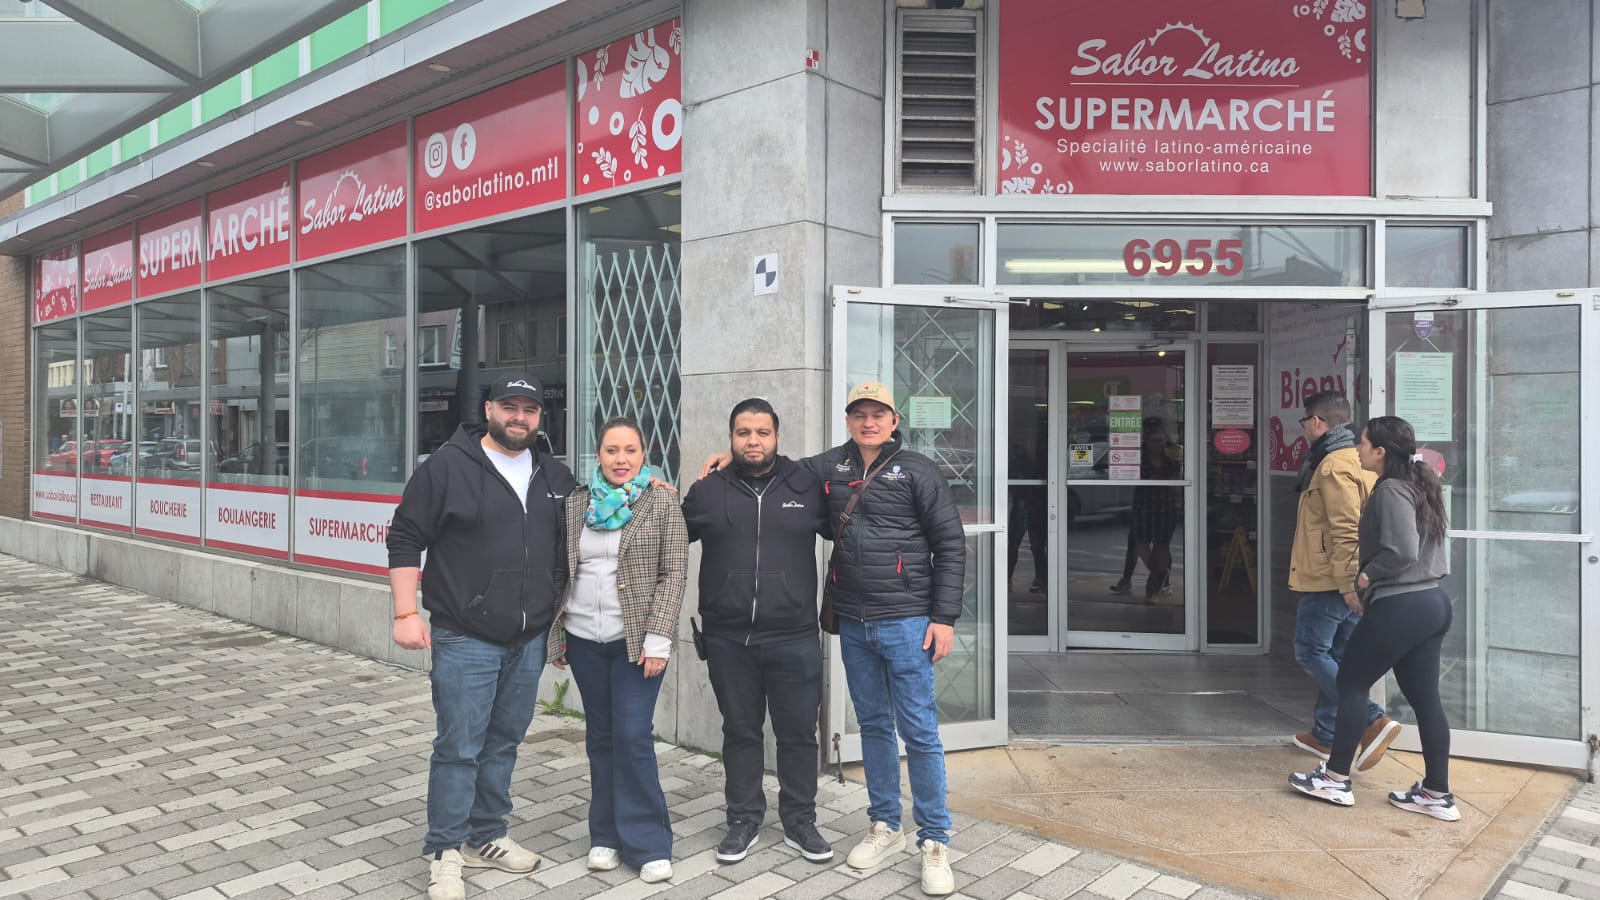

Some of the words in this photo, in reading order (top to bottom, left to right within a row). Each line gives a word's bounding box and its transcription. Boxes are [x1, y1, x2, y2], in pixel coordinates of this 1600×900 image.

[1070, 38, 1179, 78] Sabor
[1182, 41, 1300, 80] Latino
[1034, 90, 1336, 132] SUPERMARCHÉ
[1056, 138, 1147, 155] Specialité
[1154, 139, 1313, 155] latino-américaine
[1099, 158, 1271, 174] www.saborlatino.ca
[424, 156, 559, 212] @saborlatino.mtl
[301, 191, 346, 235] Sabor
[349, 183, 406, 222] Latino
[1123, 238, 1244, 277] 6955
[84, 262, 107, 293] Sabor
[107, 261, 133, 288] Latino
[1110, 416, 1142, 428] ENTRÉE
[90, 492, 123, 510] RESTAURANT
[150, 499, 188, 518] BOUCHERIE
[218, 506, 276, 530] BOULANGERIE
